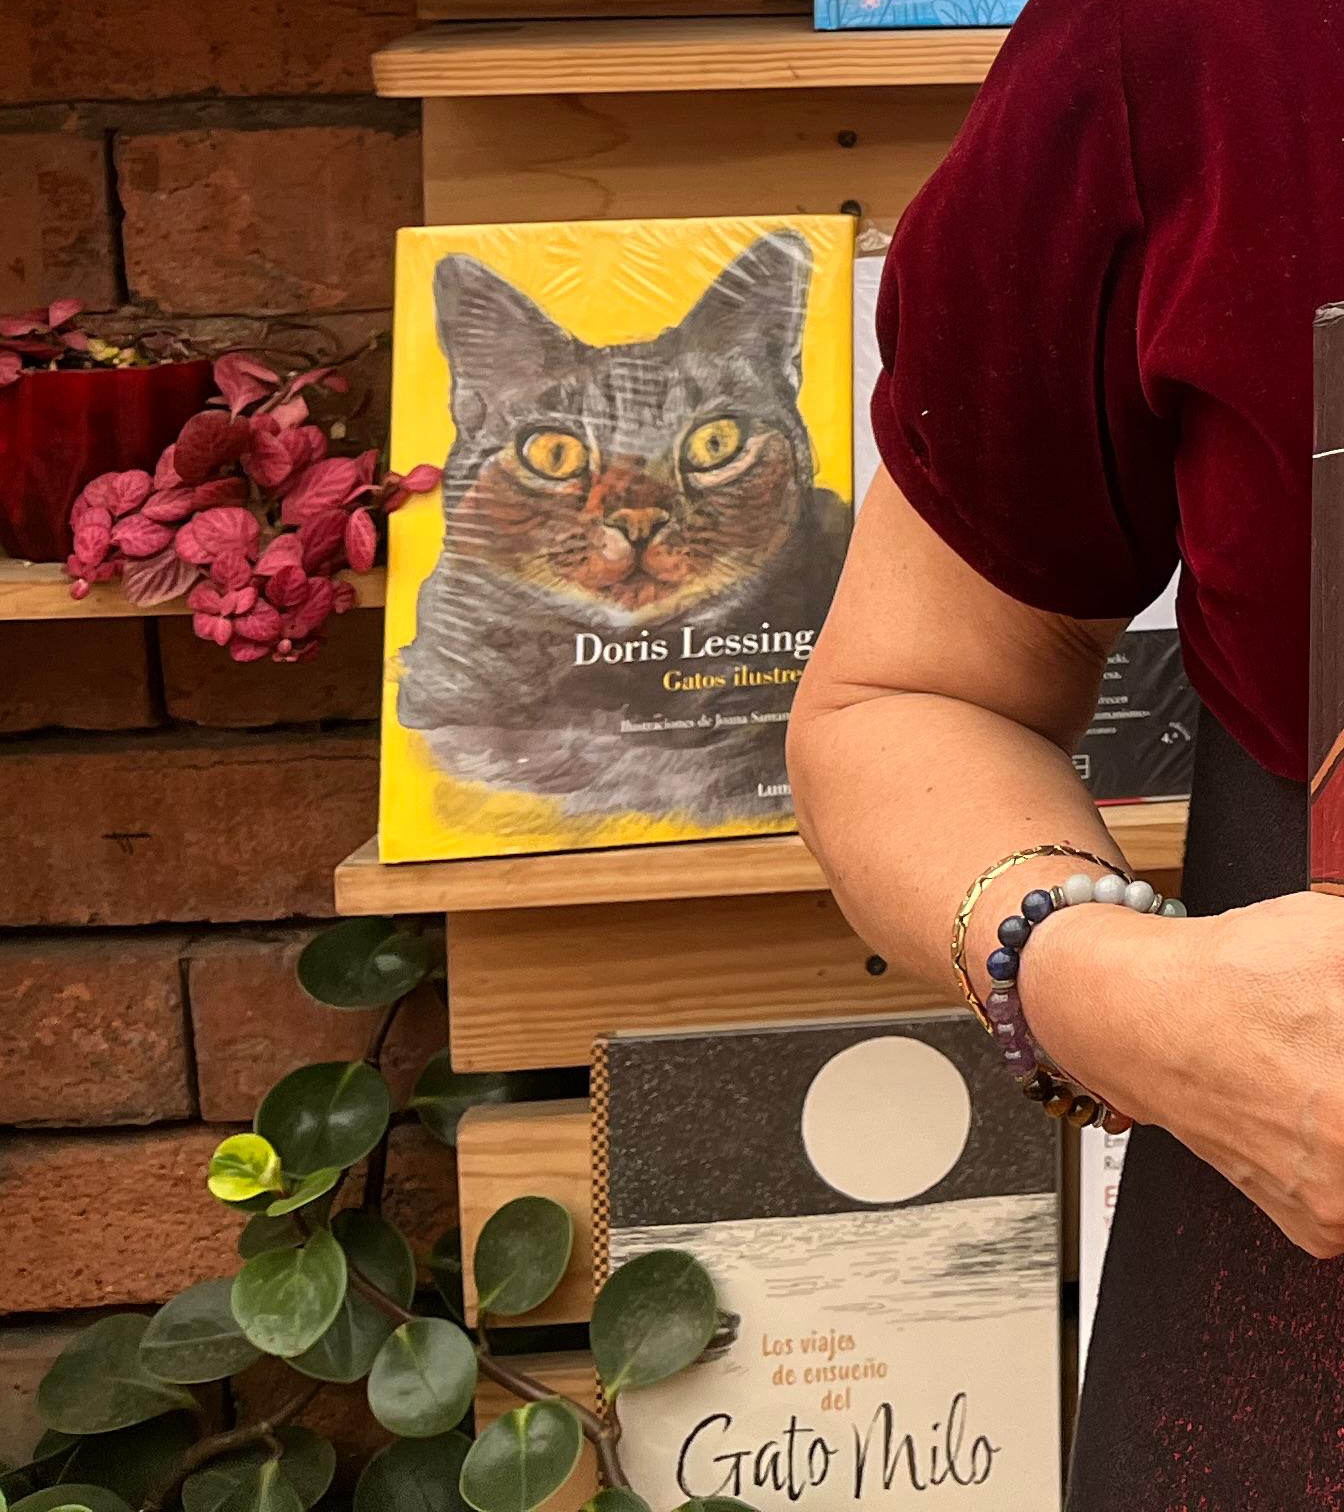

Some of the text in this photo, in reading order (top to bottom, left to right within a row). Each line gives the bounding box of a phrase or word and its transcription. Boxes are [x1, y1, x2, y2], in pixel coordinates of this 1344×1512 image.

[573, 622, 814, 666] Doris Lessing
[663, 670, 726, 691] Gatos
[761, 1328, 855, 1361] Los viajes
[772, 1358, 888, 1387] de ensueño
[821, 1388, 851, 1411] del
[676, 1392, 1001, 1502] Gato Milo
